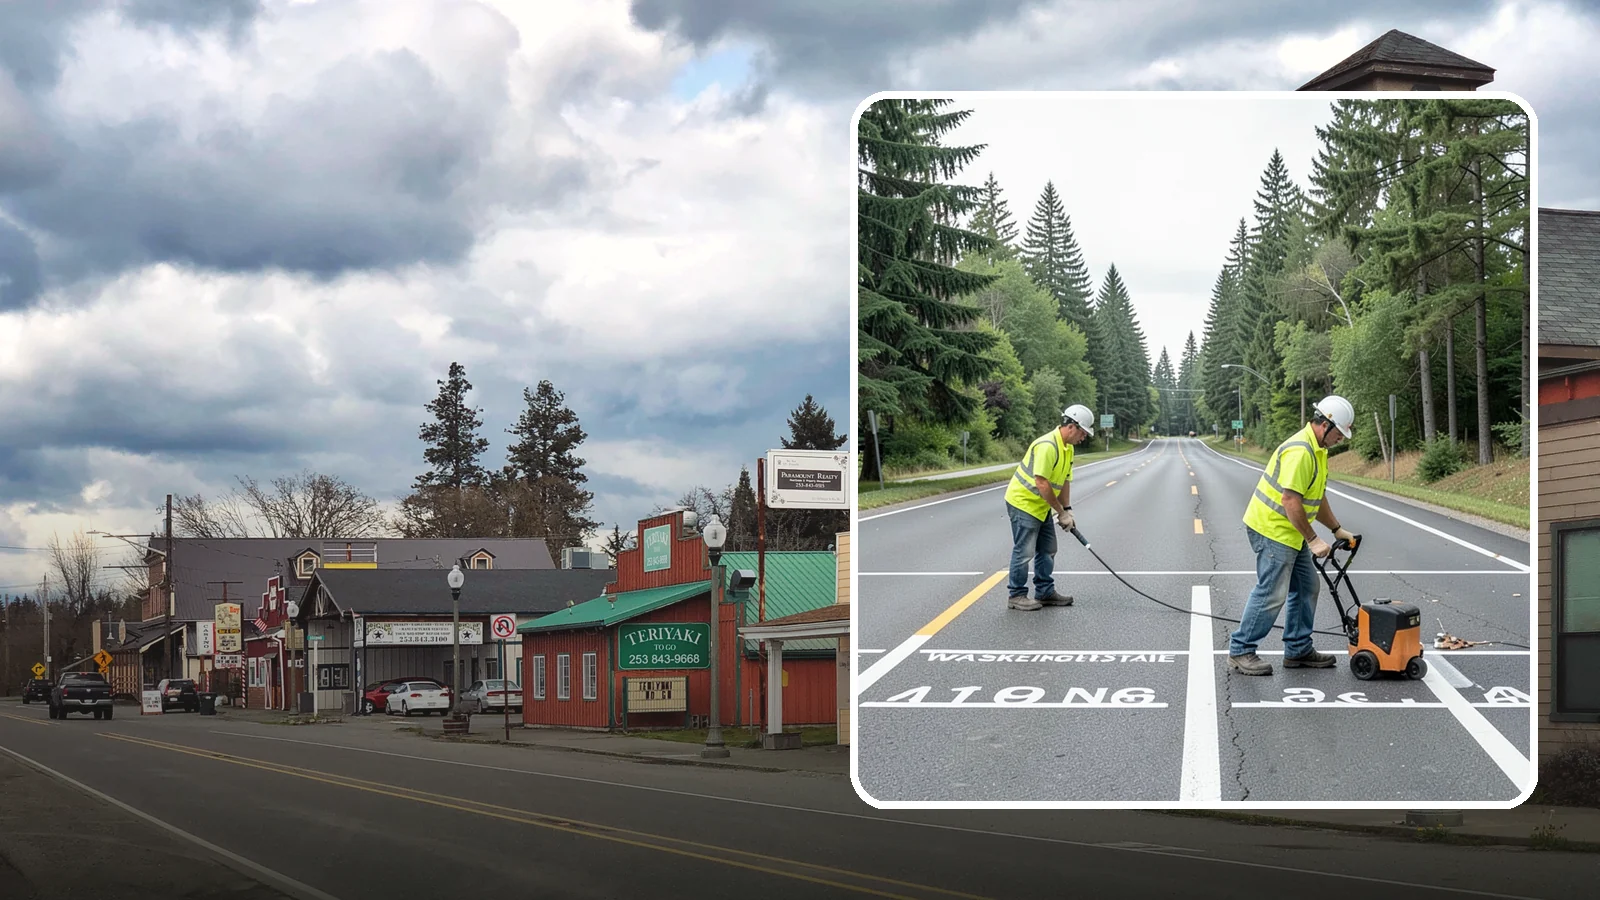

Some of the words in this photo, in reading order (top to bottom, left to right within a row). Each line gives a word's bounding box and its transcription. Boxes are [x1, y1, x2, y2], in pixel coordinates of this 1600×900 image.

[624, 627, 702, 646] TERIYAKI
[654, 643, 664, 651] TO
[665, 643, 676, 651] GO
[628, 654, 648, 665] 253
[651, 653, 700, 664] 843-9668
